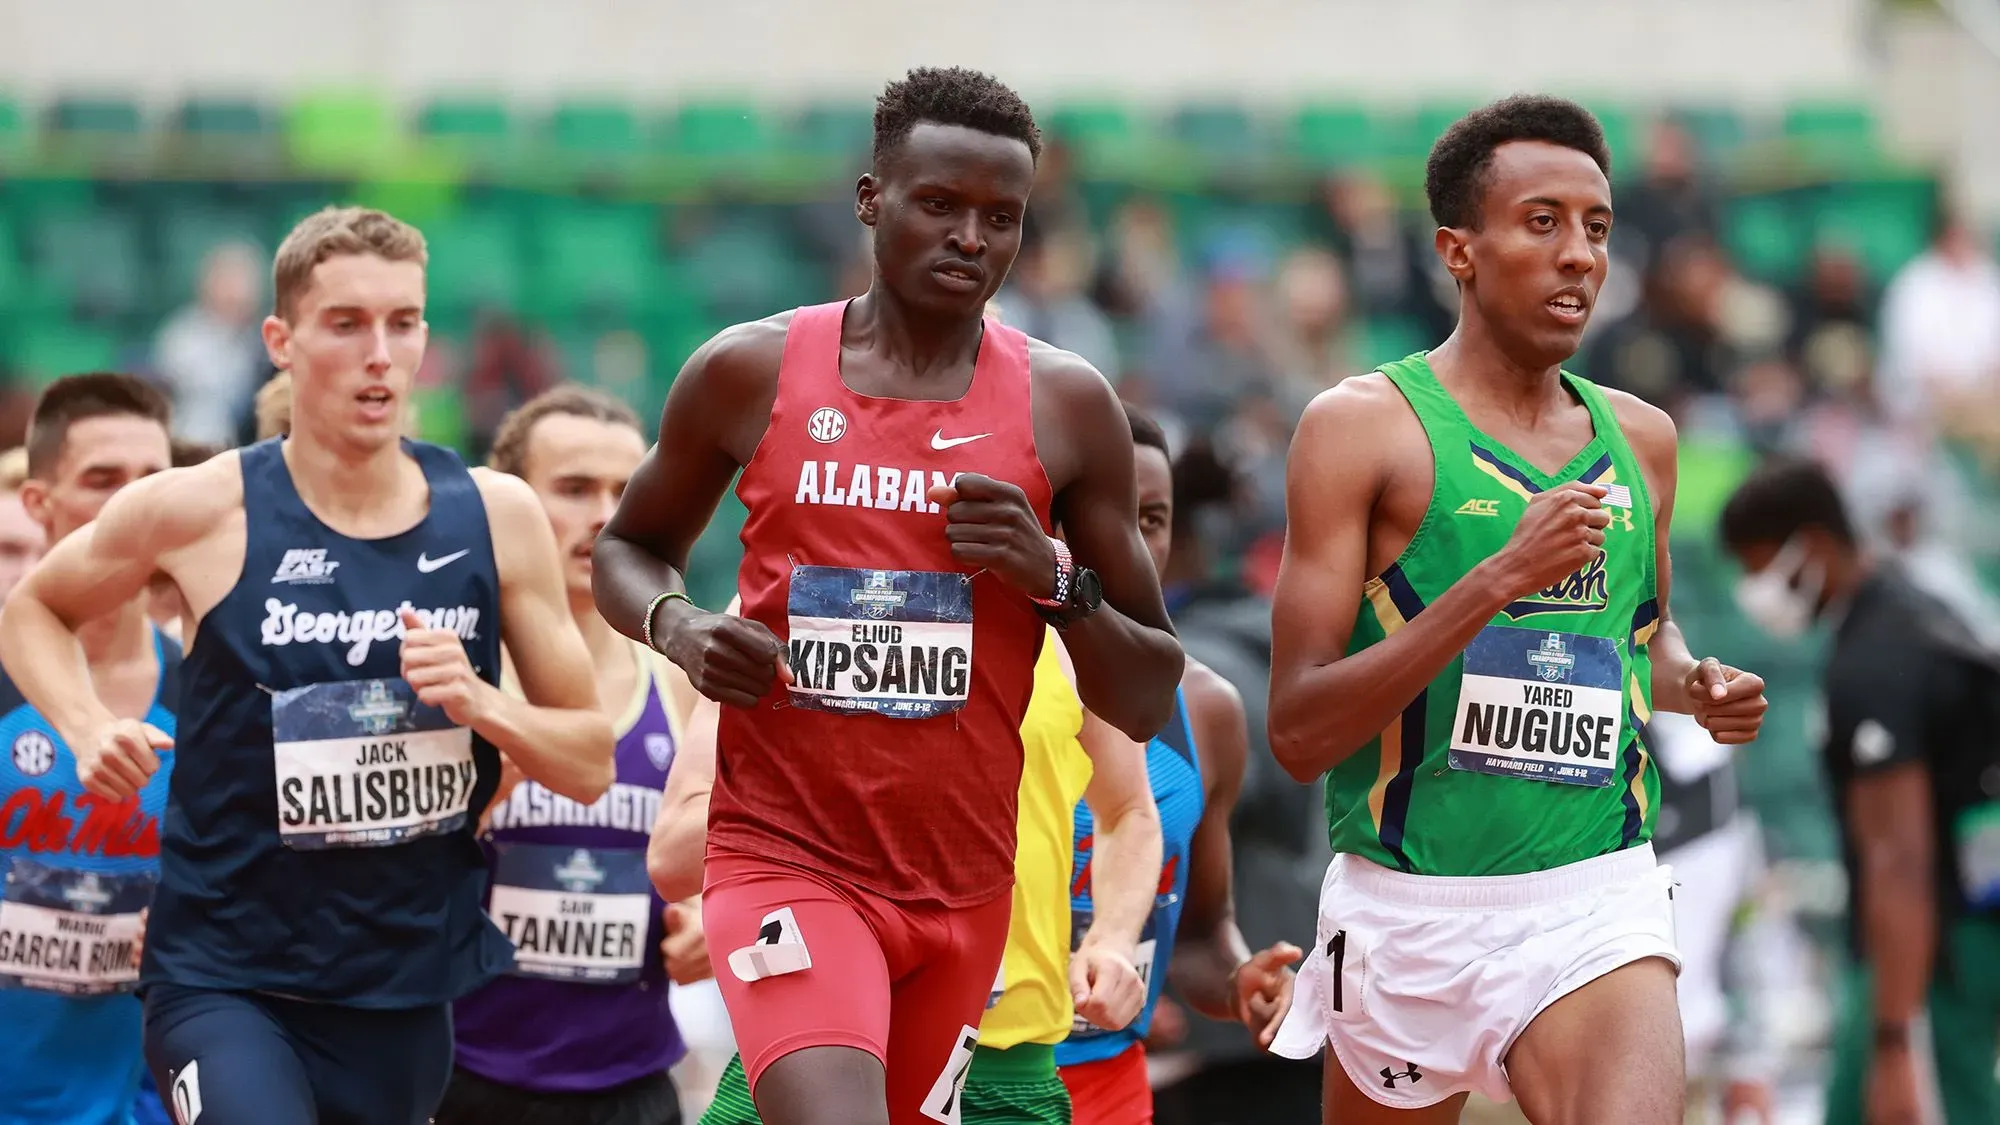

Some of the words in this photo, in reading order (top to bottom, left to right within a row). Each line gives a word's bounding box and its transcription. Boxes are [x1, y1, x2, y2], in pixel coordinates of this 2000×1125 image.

[810, 407, 845, 442] SEC
[1459, 498, 1500, 514] ACC
[852, 623, 902, 645] ELIUD
[788, 639, 967, 696] KIPSANG
[857, 700, 879, 711] FIELD
[892, 701, 913, 712] JUNE
[914, 702, 931, 712] 9-12
[1523, 684, 1573, 708] YARED
[1462, 701, 1614, 761] NUGUSE
[12, 732, 54, 775] SEC
[356, 741, 408, 766] JACK
[1485, 757, 1524, 771] HAYWARD
[1523, 761, 1545, 773] FIELD
[1556, 766, 1575, 777] JUNE
[282, 760, 473, 827] SALISBURY
[0, 929, 82, 972] GARCIA
[88, 939, 138, 976] ROM
[502, 913, 636, 959] TANNER
[1327, 929, 1347, 1013] 1
